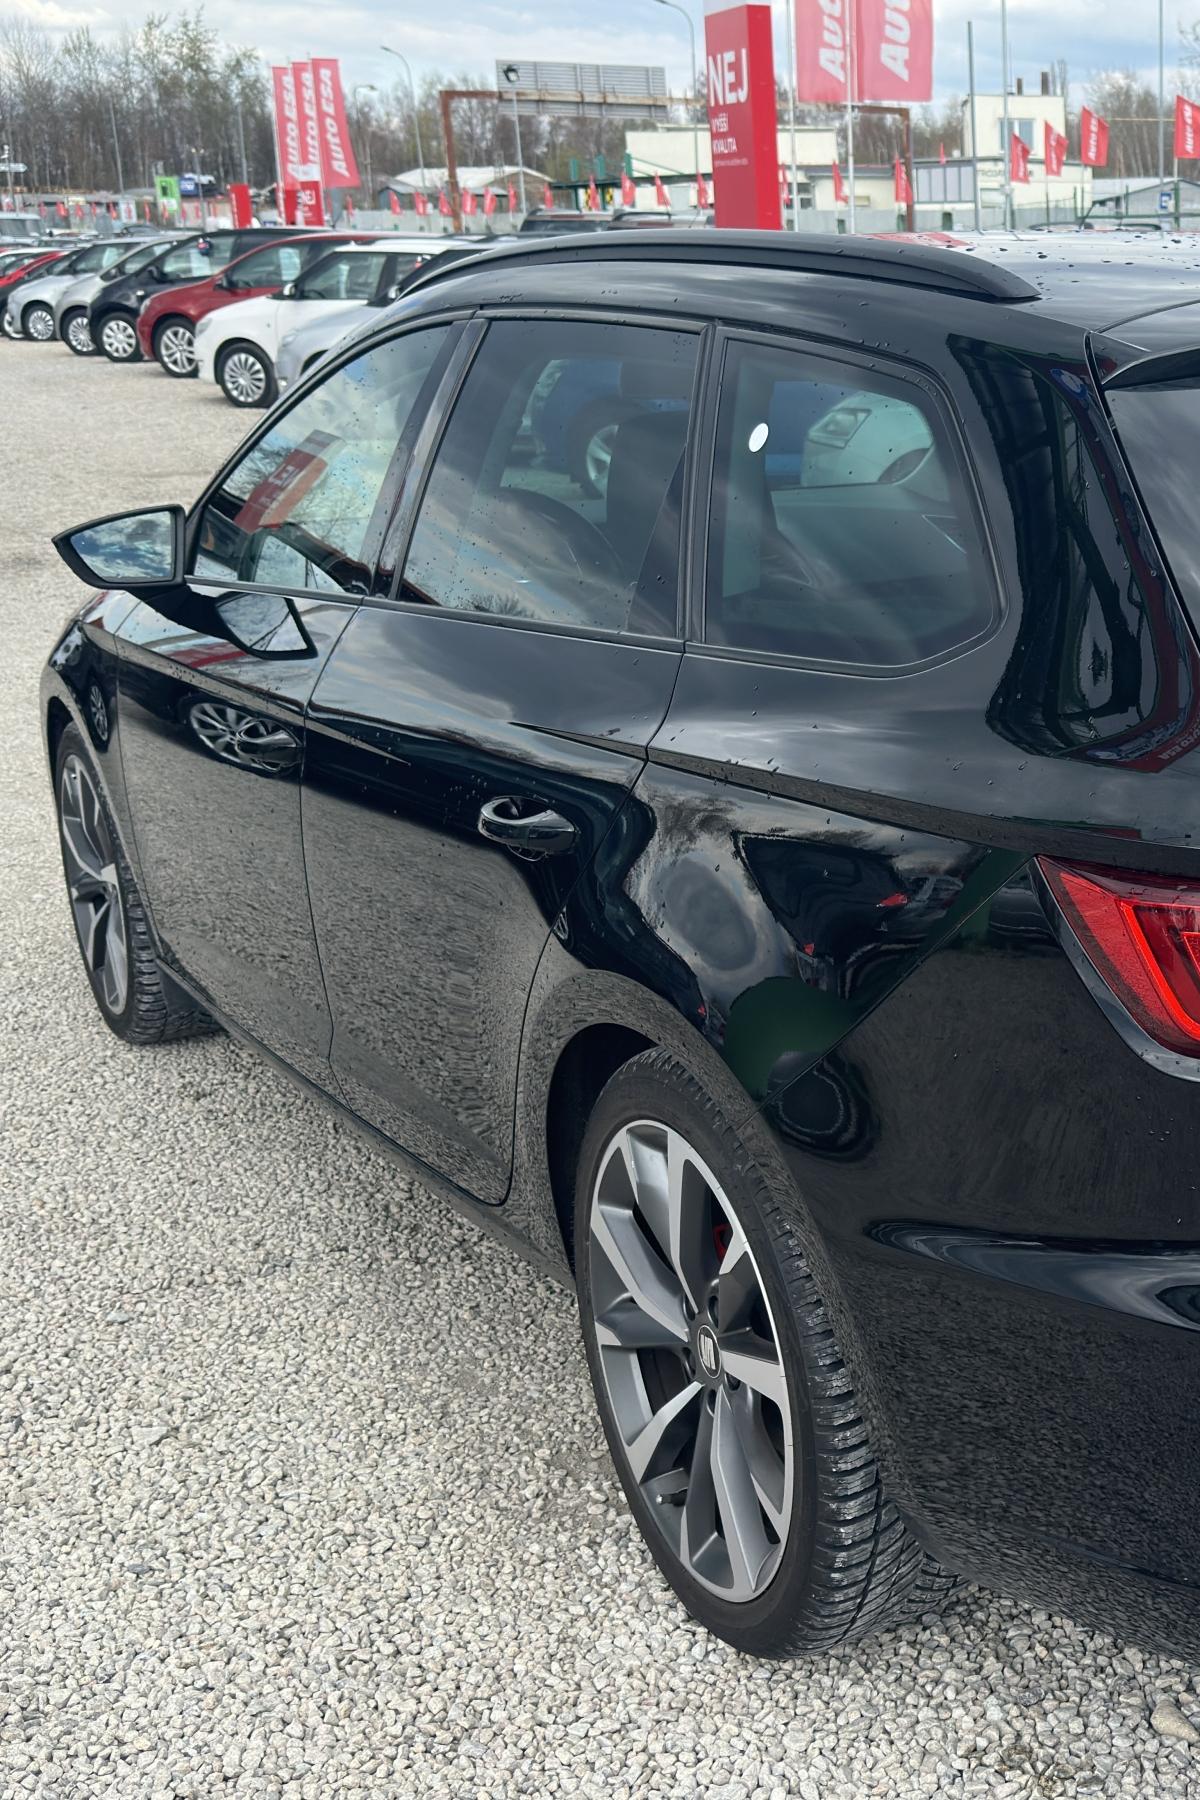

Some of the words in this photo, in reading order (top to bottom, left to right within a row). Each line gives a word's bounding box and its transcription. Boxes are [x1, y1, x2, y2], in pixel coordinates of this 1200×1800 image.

[818, 0, 846, 84] Aut
[319, 68, 335, 116] ESA
[708, 48, 749, 107] NEJ
[325, 116, 350, 178] Auto
[1087, 133, 1098, 160] Auto
[1184, 127, 1195, 154] Auto
